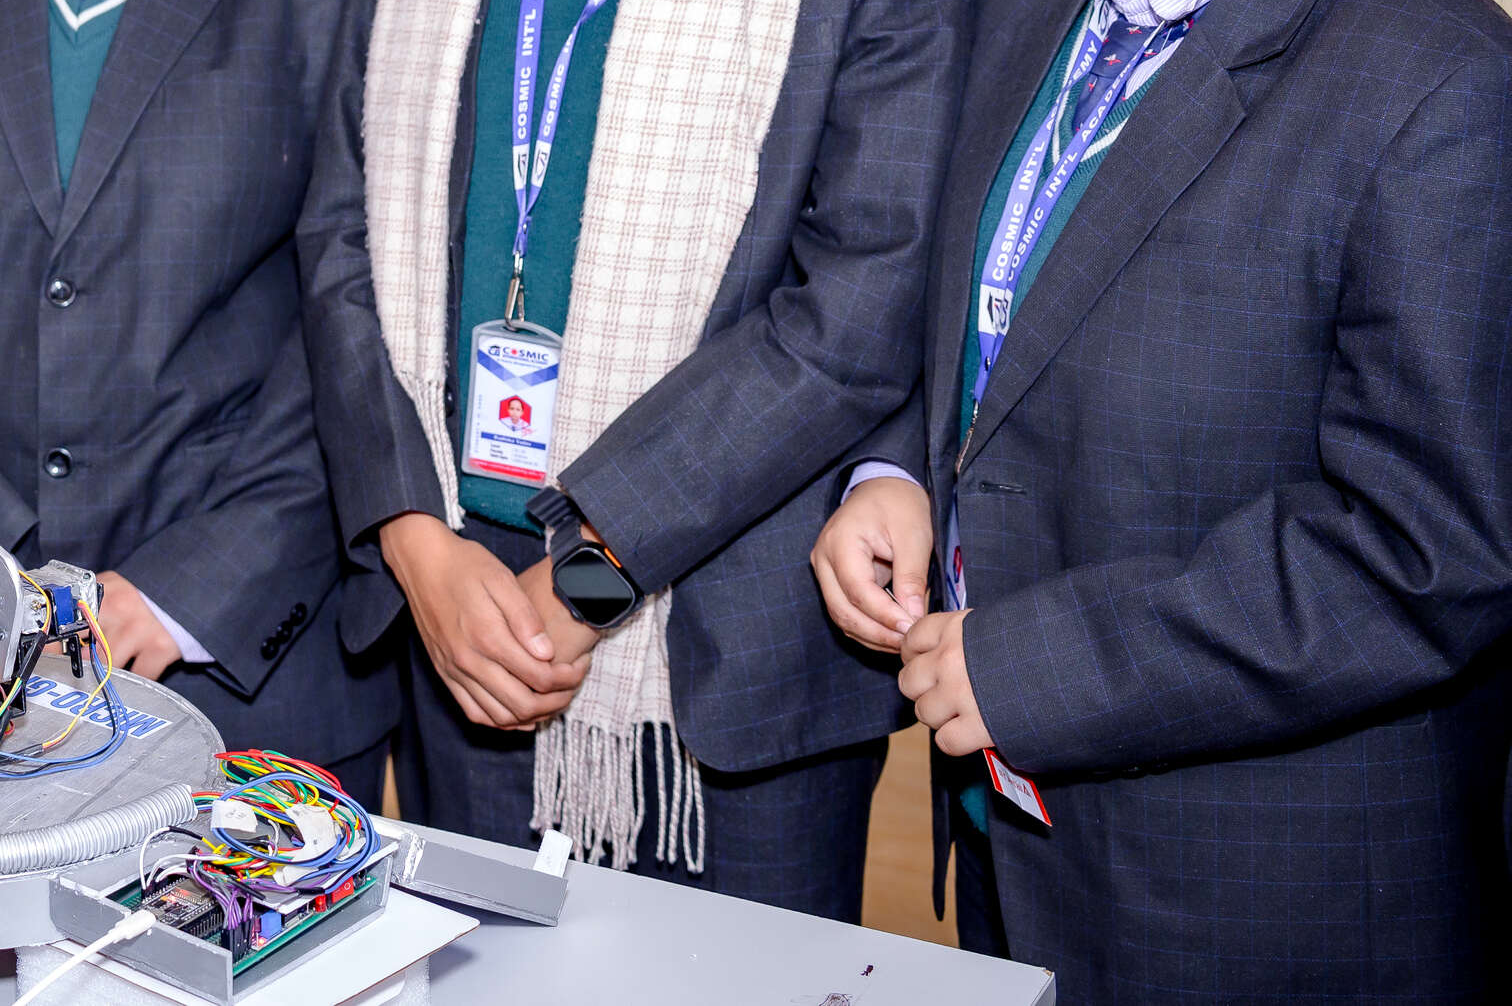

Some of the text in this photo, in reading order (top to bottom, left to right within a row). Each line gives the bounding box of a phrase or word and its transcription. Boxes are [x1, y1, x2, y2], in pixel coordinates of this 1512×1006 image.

[521, 8, 536, 56] INT'L
[518, 66, 532, 139] COSMIC
[543, 63, 565, 137] COSMIC
[992, 202, 1024, 281] COSMIC
[1018, 141, 1045, 191] INT'L
[1045, 150, 1078, 199] INT'L
